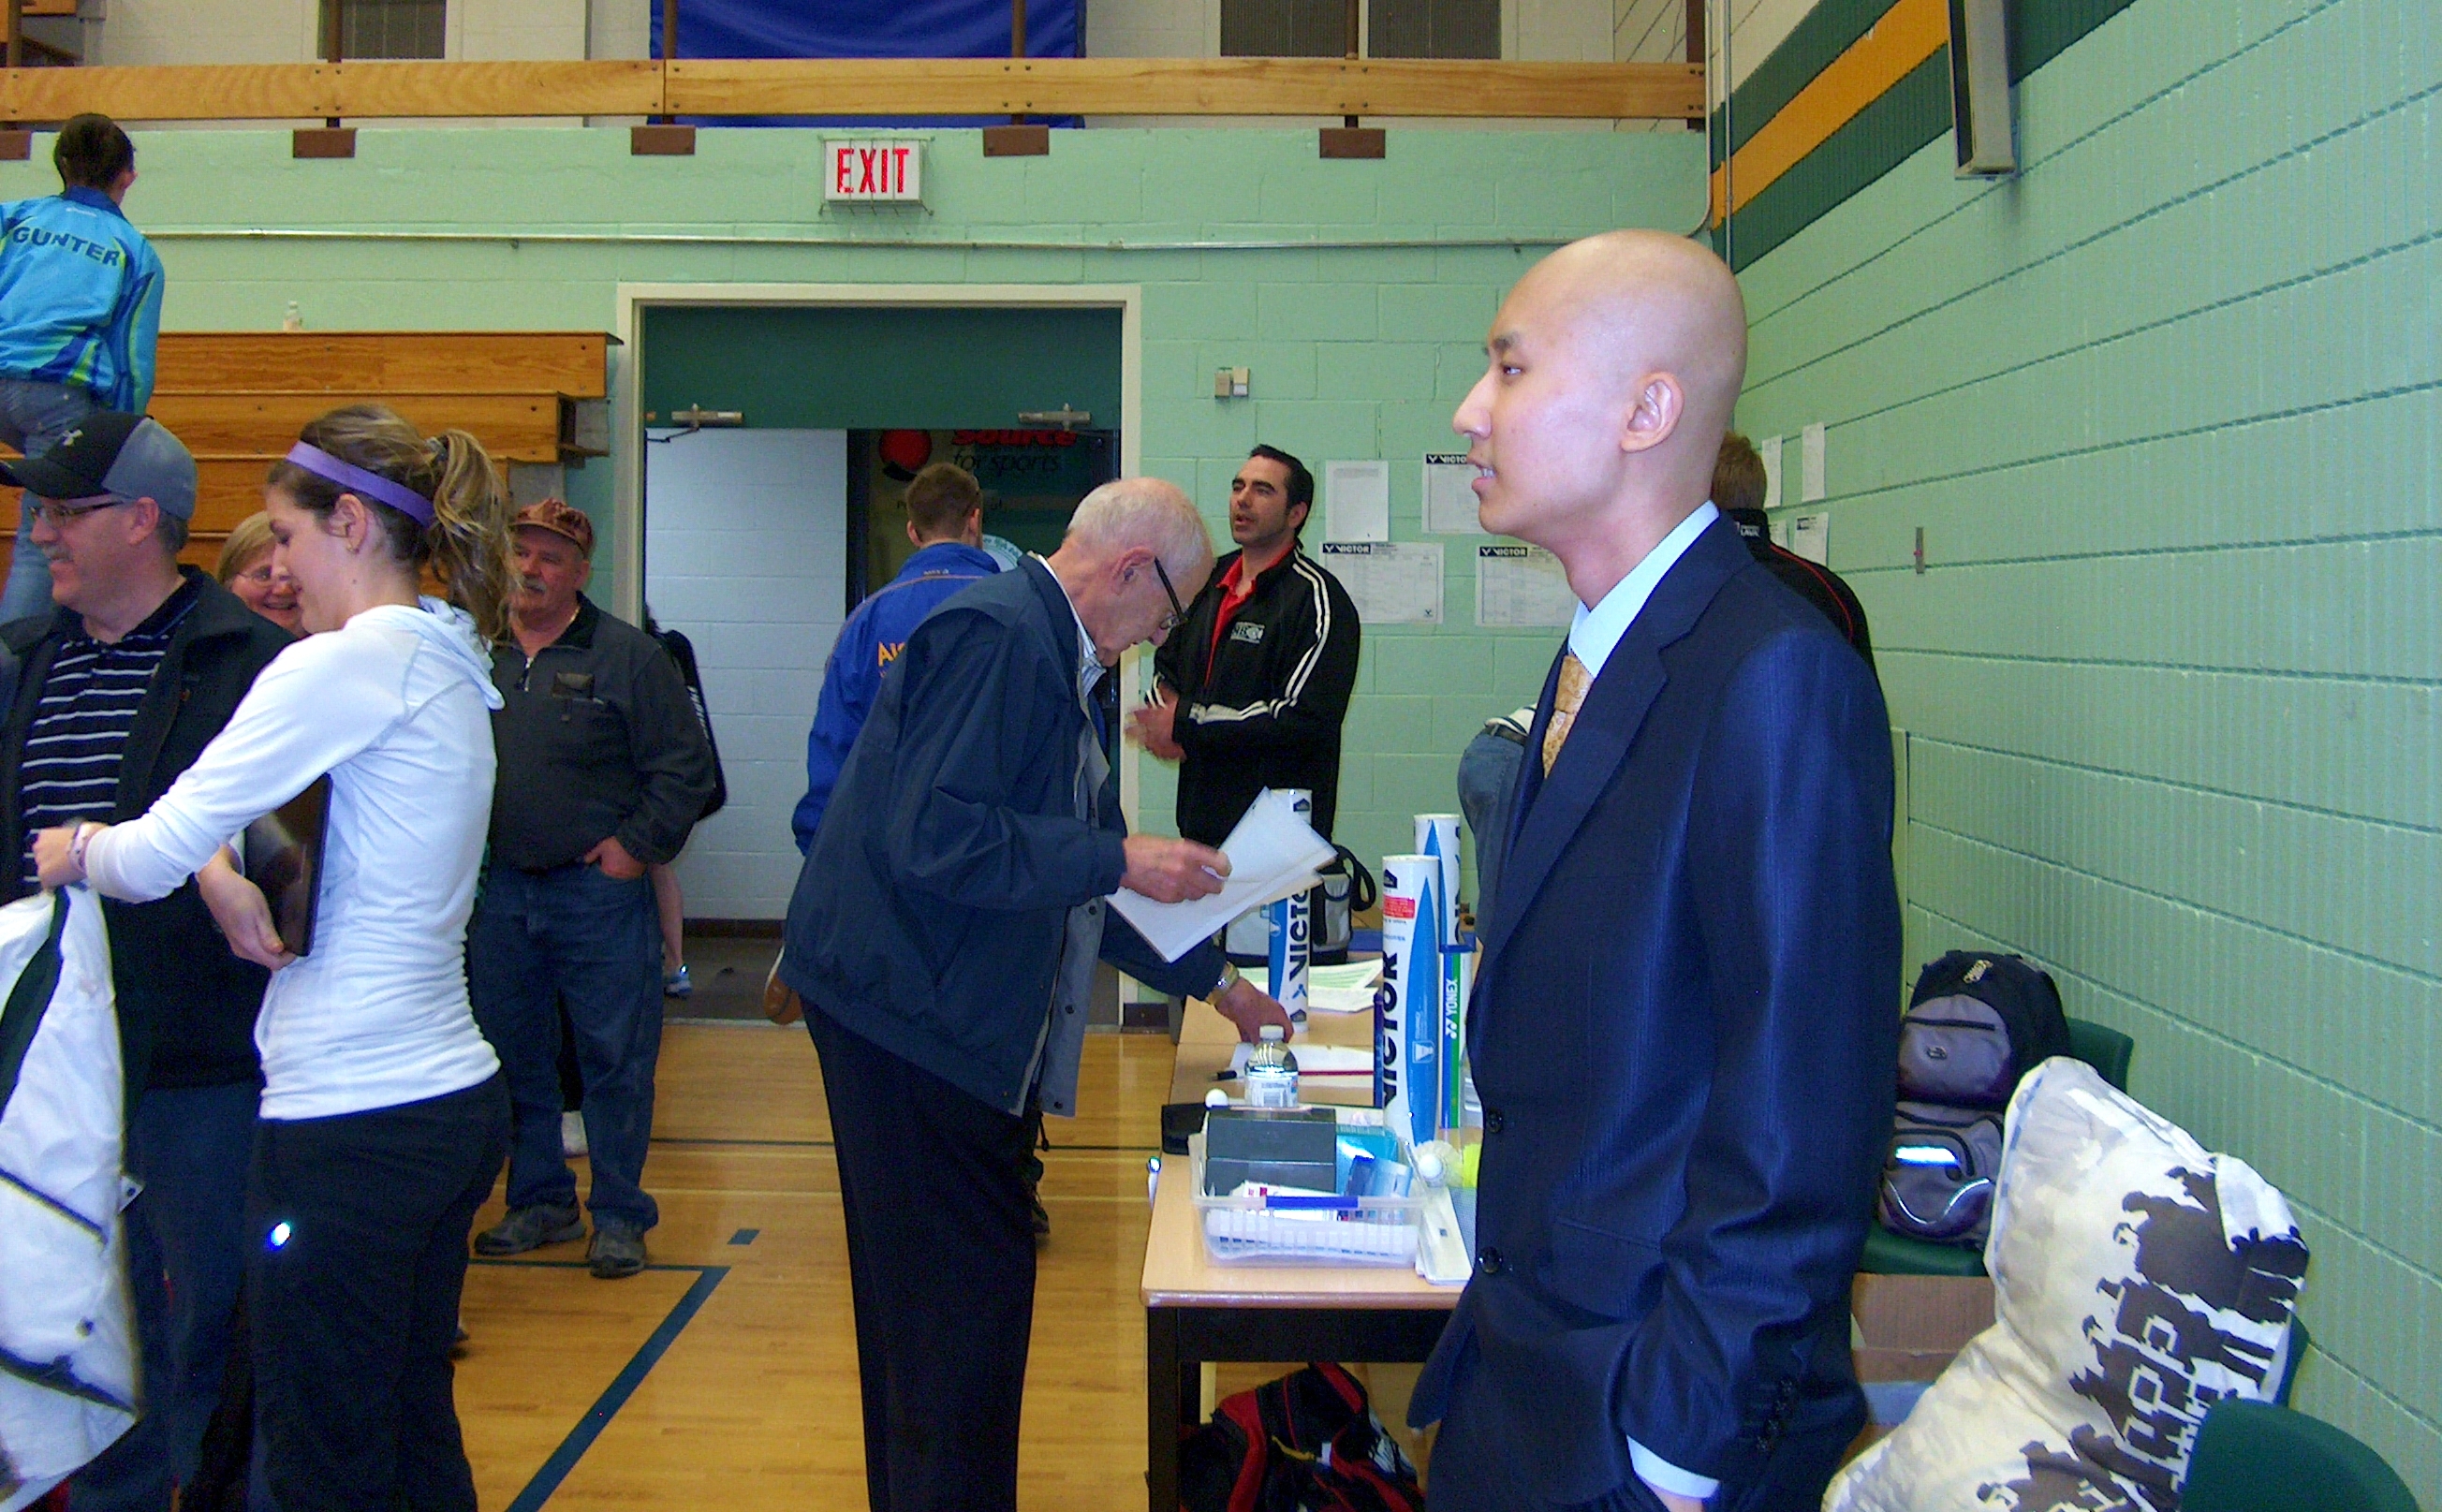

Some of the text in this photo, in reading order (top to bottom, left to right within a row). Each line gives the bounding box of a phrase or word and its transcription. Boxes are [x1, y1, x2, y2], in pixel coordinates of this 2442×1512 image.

[837, 148, 909, 193] EXIT
[12, 226, 120, 266] GUNTER
[1439, 454, 1467, 463] VICTO
[1335, 545, 1370, 554] VICTOR
[1493, 547, 1526, 556] VICTOR
[1289, 889, 1309, 982] VICT
[1446, 977, 1459, 1016] YONEX
[1383, 950, 1398, 1108] VICTOR
